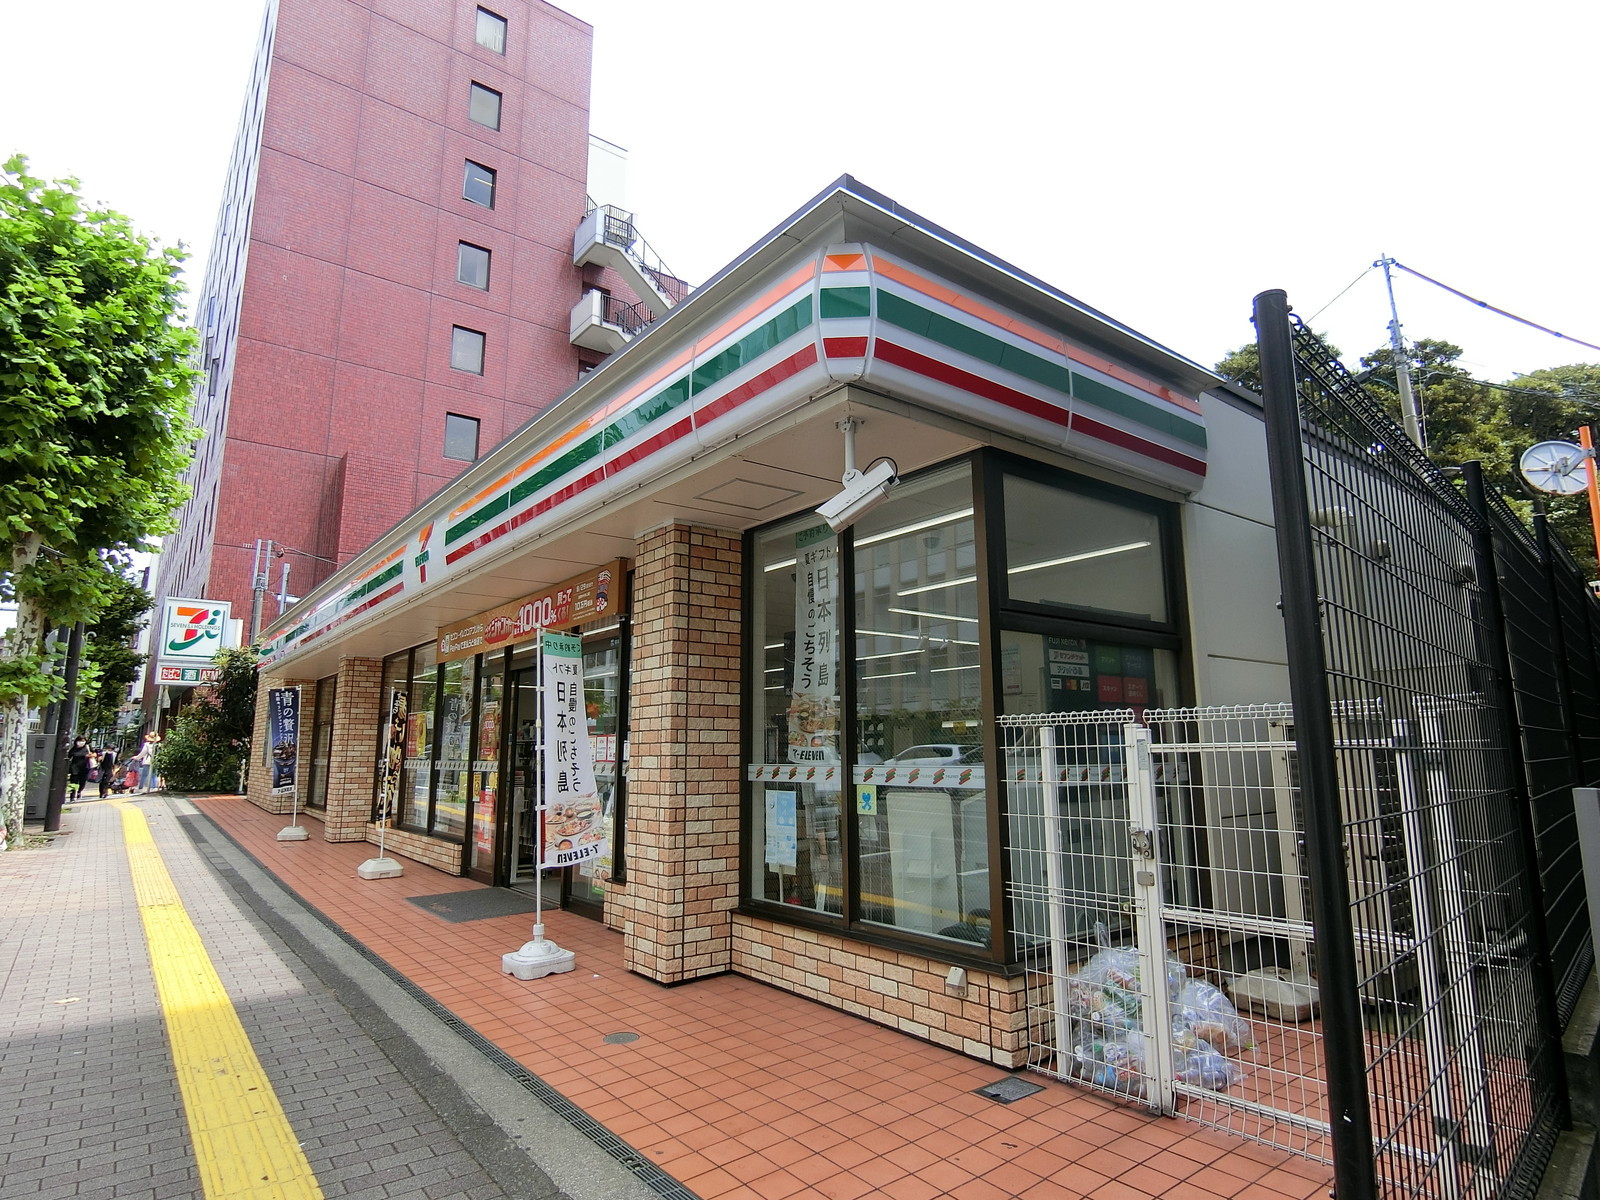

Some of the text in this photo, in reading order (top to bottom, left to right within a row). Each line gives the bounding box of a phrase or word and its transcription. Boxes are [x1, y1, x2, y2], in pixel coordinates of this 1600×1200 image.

[817, 566, 831, 687] 日本列島
[201, 670, 219, 681] ATM
[280, 691, 295, 747] 青の贅沢
